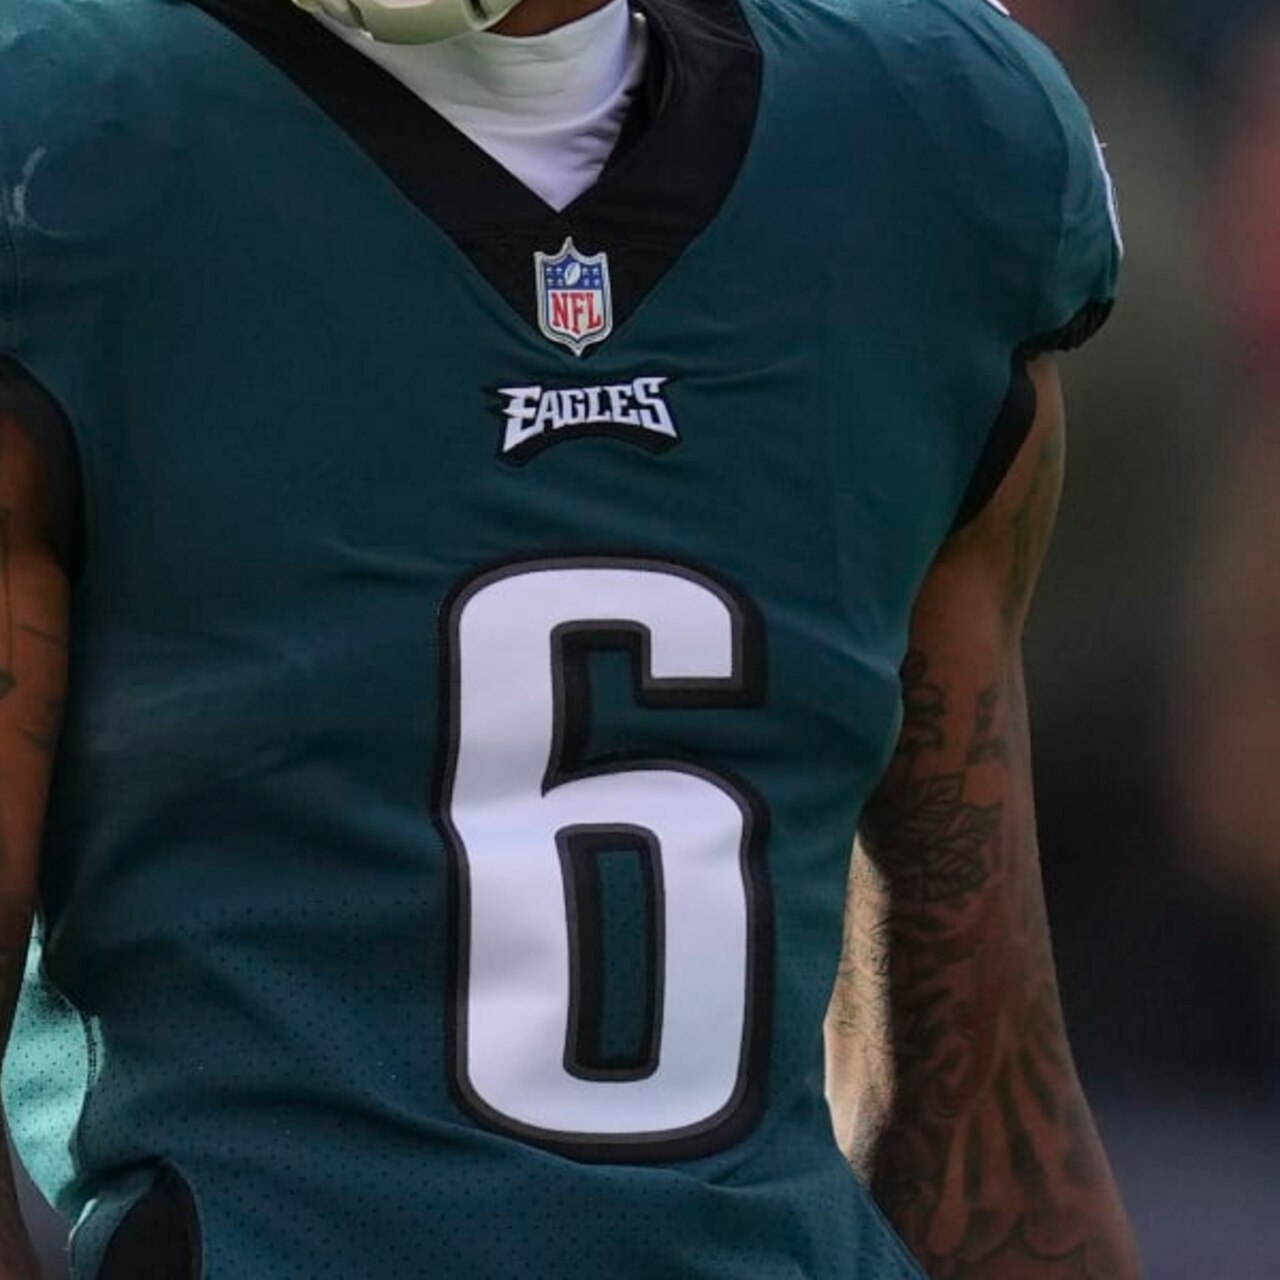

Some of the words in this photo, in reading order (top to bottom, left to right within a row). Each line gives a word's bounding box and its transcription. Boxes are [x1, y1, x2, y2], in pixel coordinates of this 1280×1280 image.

[549, 291, 604, 335] NFL
[496, 375, 678, 454] EAGLES
[446, 563, 750, 1138] 6
